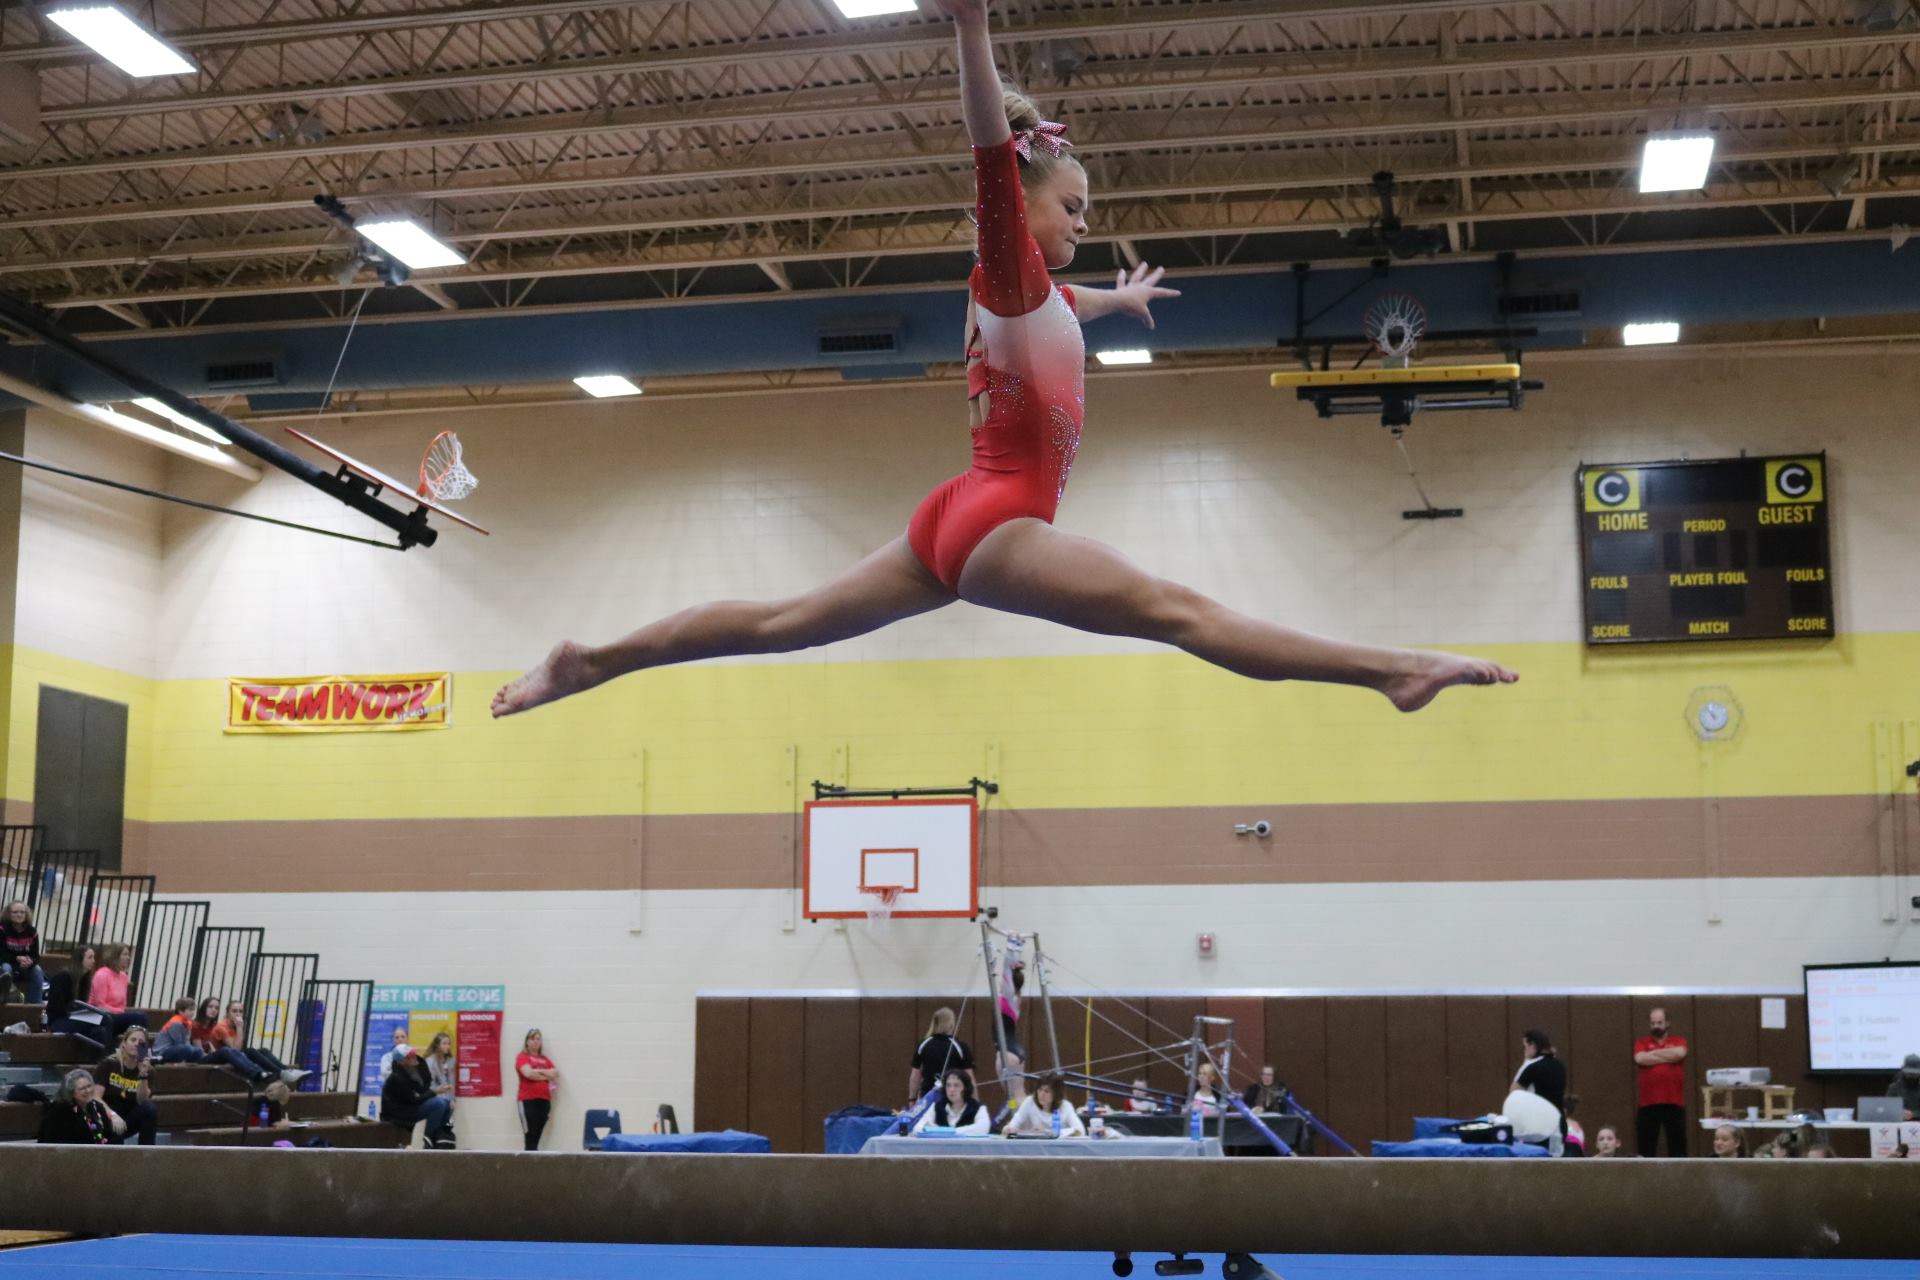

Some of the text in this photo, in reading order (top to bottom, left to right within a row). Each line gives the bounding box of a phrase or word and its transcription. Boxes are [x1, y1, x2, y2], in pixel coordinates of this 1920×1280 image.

[1598, 473, 1624, 503] C
[1780, 467, 1806, 497] C
[1598, 512, 1649, 531] HOME
[1758, 506, 1816, 525] GUEST
[1683, 519, 1726, 533] PERIOD
[1669, 572, 1748, 586] PLAYER FOUL
[1786, 568, 1825, 582] FOULS
[1590, 576, 1628, 589] FOULS
[1592, 624, 1631, 638] SCORE
[1689, 621, 1729, 635] MATCH
[1787, 618, 1827, 631] SCORE
[241, 684, 435, 721] TEAMWORK
[371, 989, 500, 1002] GET IN THE ZONE
